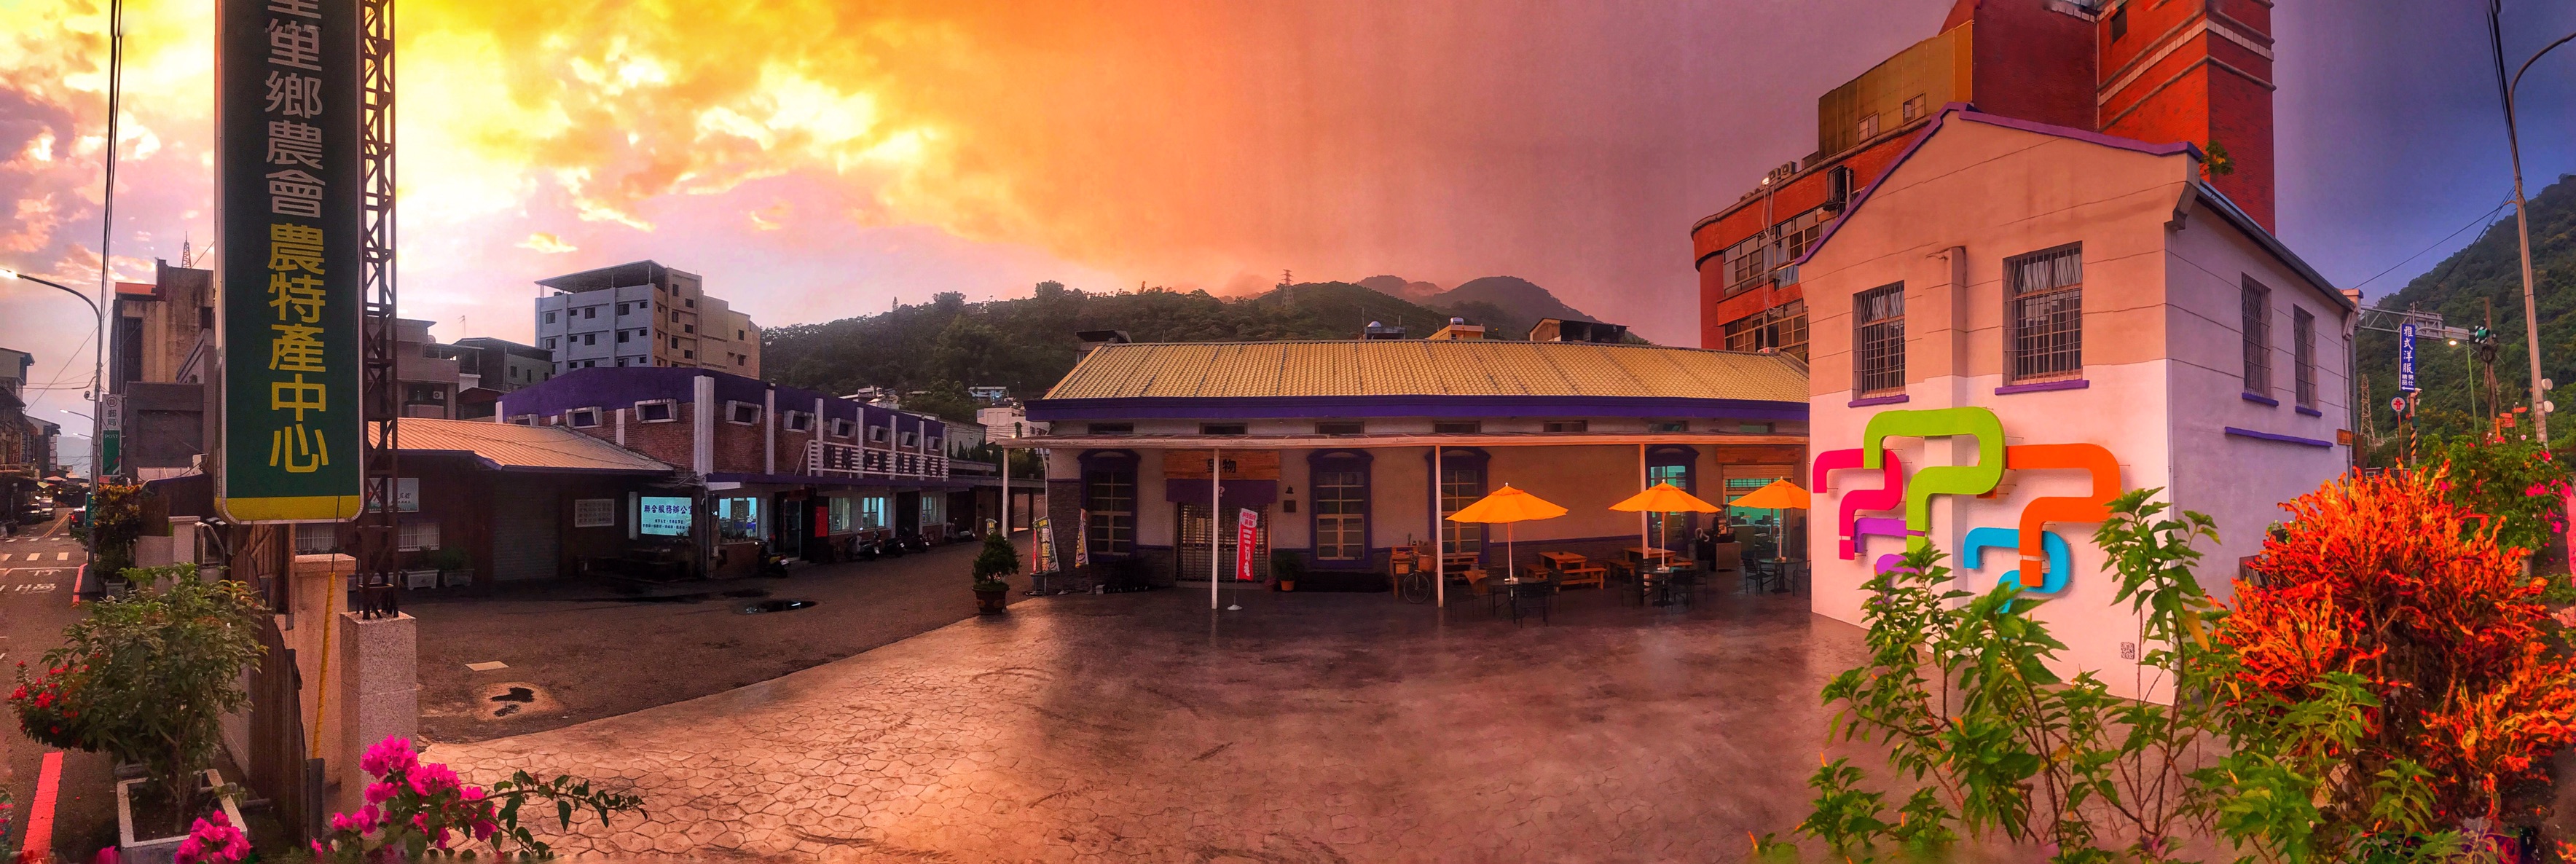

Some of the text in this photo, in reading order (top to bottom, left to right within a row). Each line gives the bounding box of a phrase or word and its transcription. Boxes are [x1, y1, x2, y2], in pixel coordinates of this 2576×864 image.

[2403, 326, 2414, 374] 雅式洋服
[107, 409, 117, 427] 郵局
